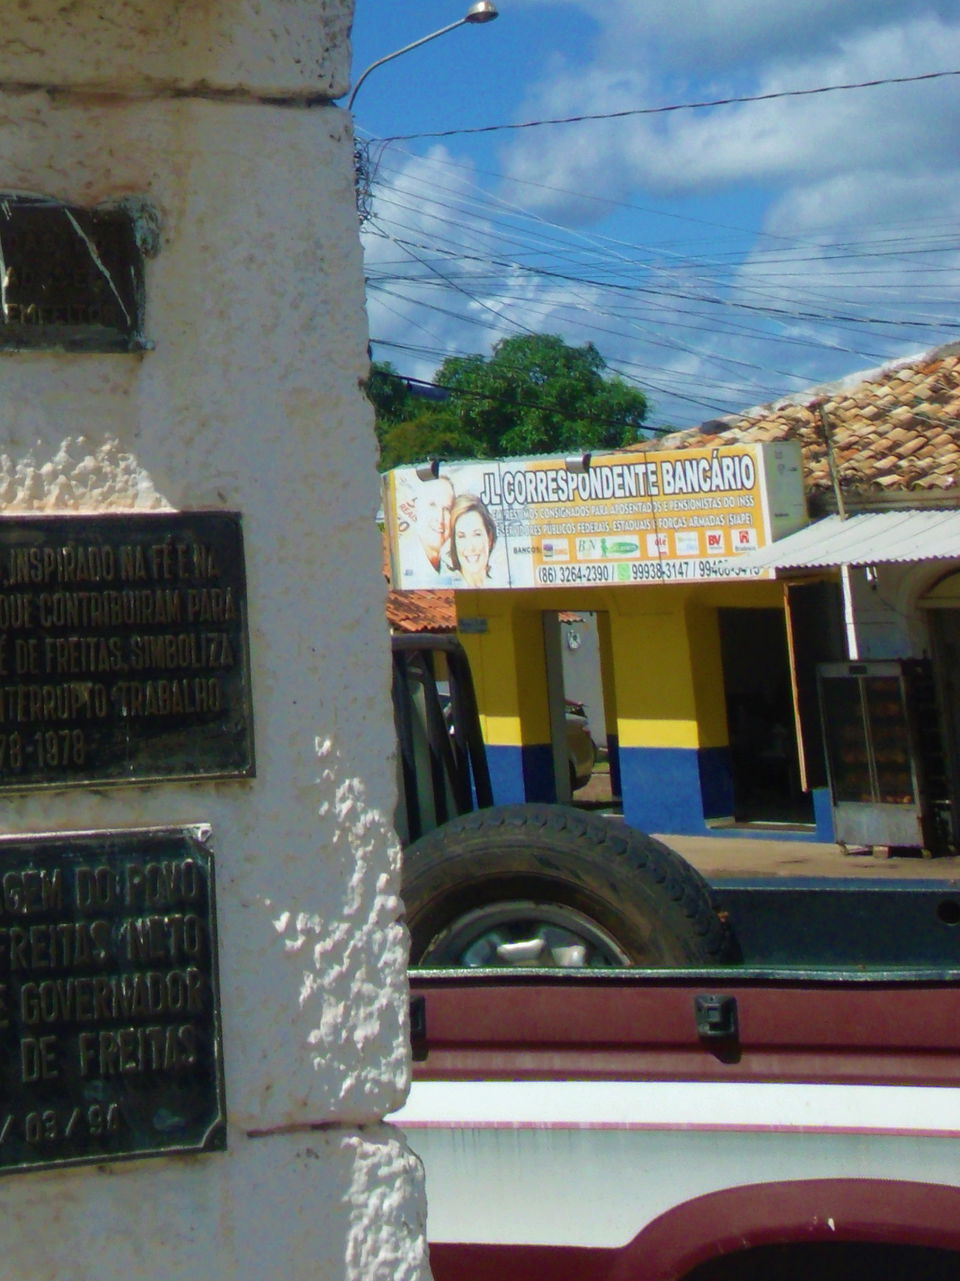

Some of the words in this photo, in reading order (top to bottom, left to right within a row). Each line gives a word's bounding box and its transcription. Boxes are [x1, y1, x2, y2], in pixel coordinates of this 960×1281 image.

[480, 471, 502, 505] JL
[502, 461, 659, 505] CORRESPONDENTE
[661, 449, 756, 495] BANCÁRIO
[11, 546, 114, 584] INSPIRADO
[538, 565, 557, 584] (86)
[559, 564, 609, 583] 3264-2390
[631, 560, 689, 581] 99938-3147
[186, 586, 236, 623] PARA
[15, 639, 41, 674] DE
[130, 631, 235, 670] SIMBOLIZA
[113, 677, 222, 717] TRABALHO
[75, 865, 115, 907] DO
[124, 857, 201, 906] POVO
[125, 912, 203, 961] NETO
[19, 966, 204, 1025] GOVERNADOR
[19, 1034, 60, 1085] DE
[77, 1023, 198, 1078] FREITAS
